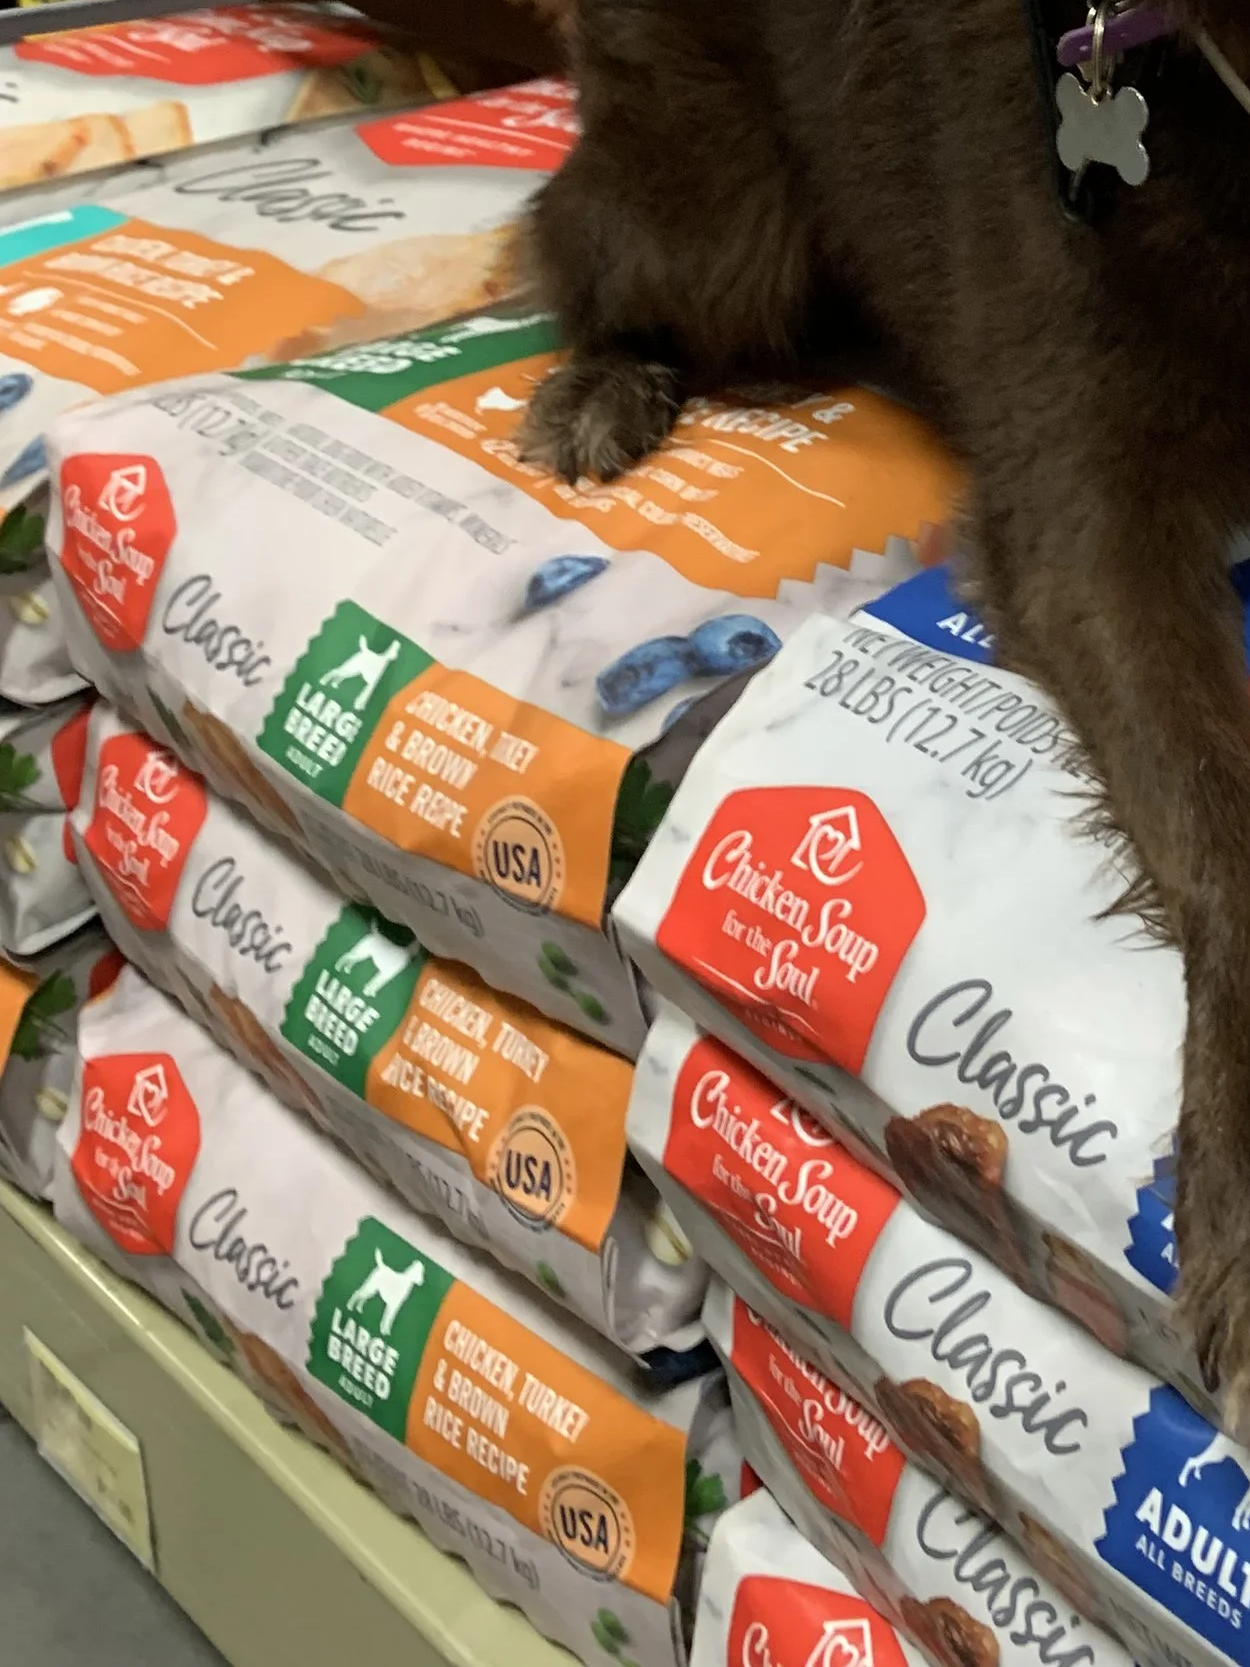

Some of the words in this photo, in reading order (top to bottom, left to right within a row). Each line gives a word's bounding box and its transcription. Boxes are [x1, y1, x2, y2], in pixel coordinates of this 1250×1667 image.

[173, 156, 406, 233] Classic
[162, 573, 272, 687] Classic
[400, 729, 479, 791] BROWN
[803, 649, 860, 698] 28
[838, 667, 913, 724] LBS
[960, 738, 1033, 801] kg)
[366, 756, 416, 807] RICE
[492, 839, 542, 889] USA
[192, 856, 293, 974] Classic
[702, 829, 811, 933] Chicken
[801, 897, 880, 984] Soup
[721, 909, 748, 942] for
[744, 924, 773, 958] the
[314, 968, 381, 1033] LARGE
[753, 938, 821, 1008] Soul
[304, 993, 360, 1057] BREED
[905, 977, 1120, 1169] Classic
[504, 1148, 552, 1203] USA
[690, 1069, 788, 1186] Chicken
[777, 1159, 859, 1249] Soup
[188, 1186, 300, 1310] Classic
[326, 1334, 392, 1401] BREED
[331, 1307, 401, 1377] LARGE
[883, 1256, 1090, 1457] Classic
[432, 1358, 448, 1393] &
[447, 1368, 510, 1440] BROWN
[443, 1318, 521, 1402] CHICKEN,
[518, 1372, 591, 1445] TURKEY
[423, 1394, 464, 1450] RICE
[466, 1424, 530, 1496] RECIPE
[559, 1504, 610, 1556] USA
[1133, 1530, 1169, 1577] ALL
[1169, 1560, 1245, 1634] BREEDS
